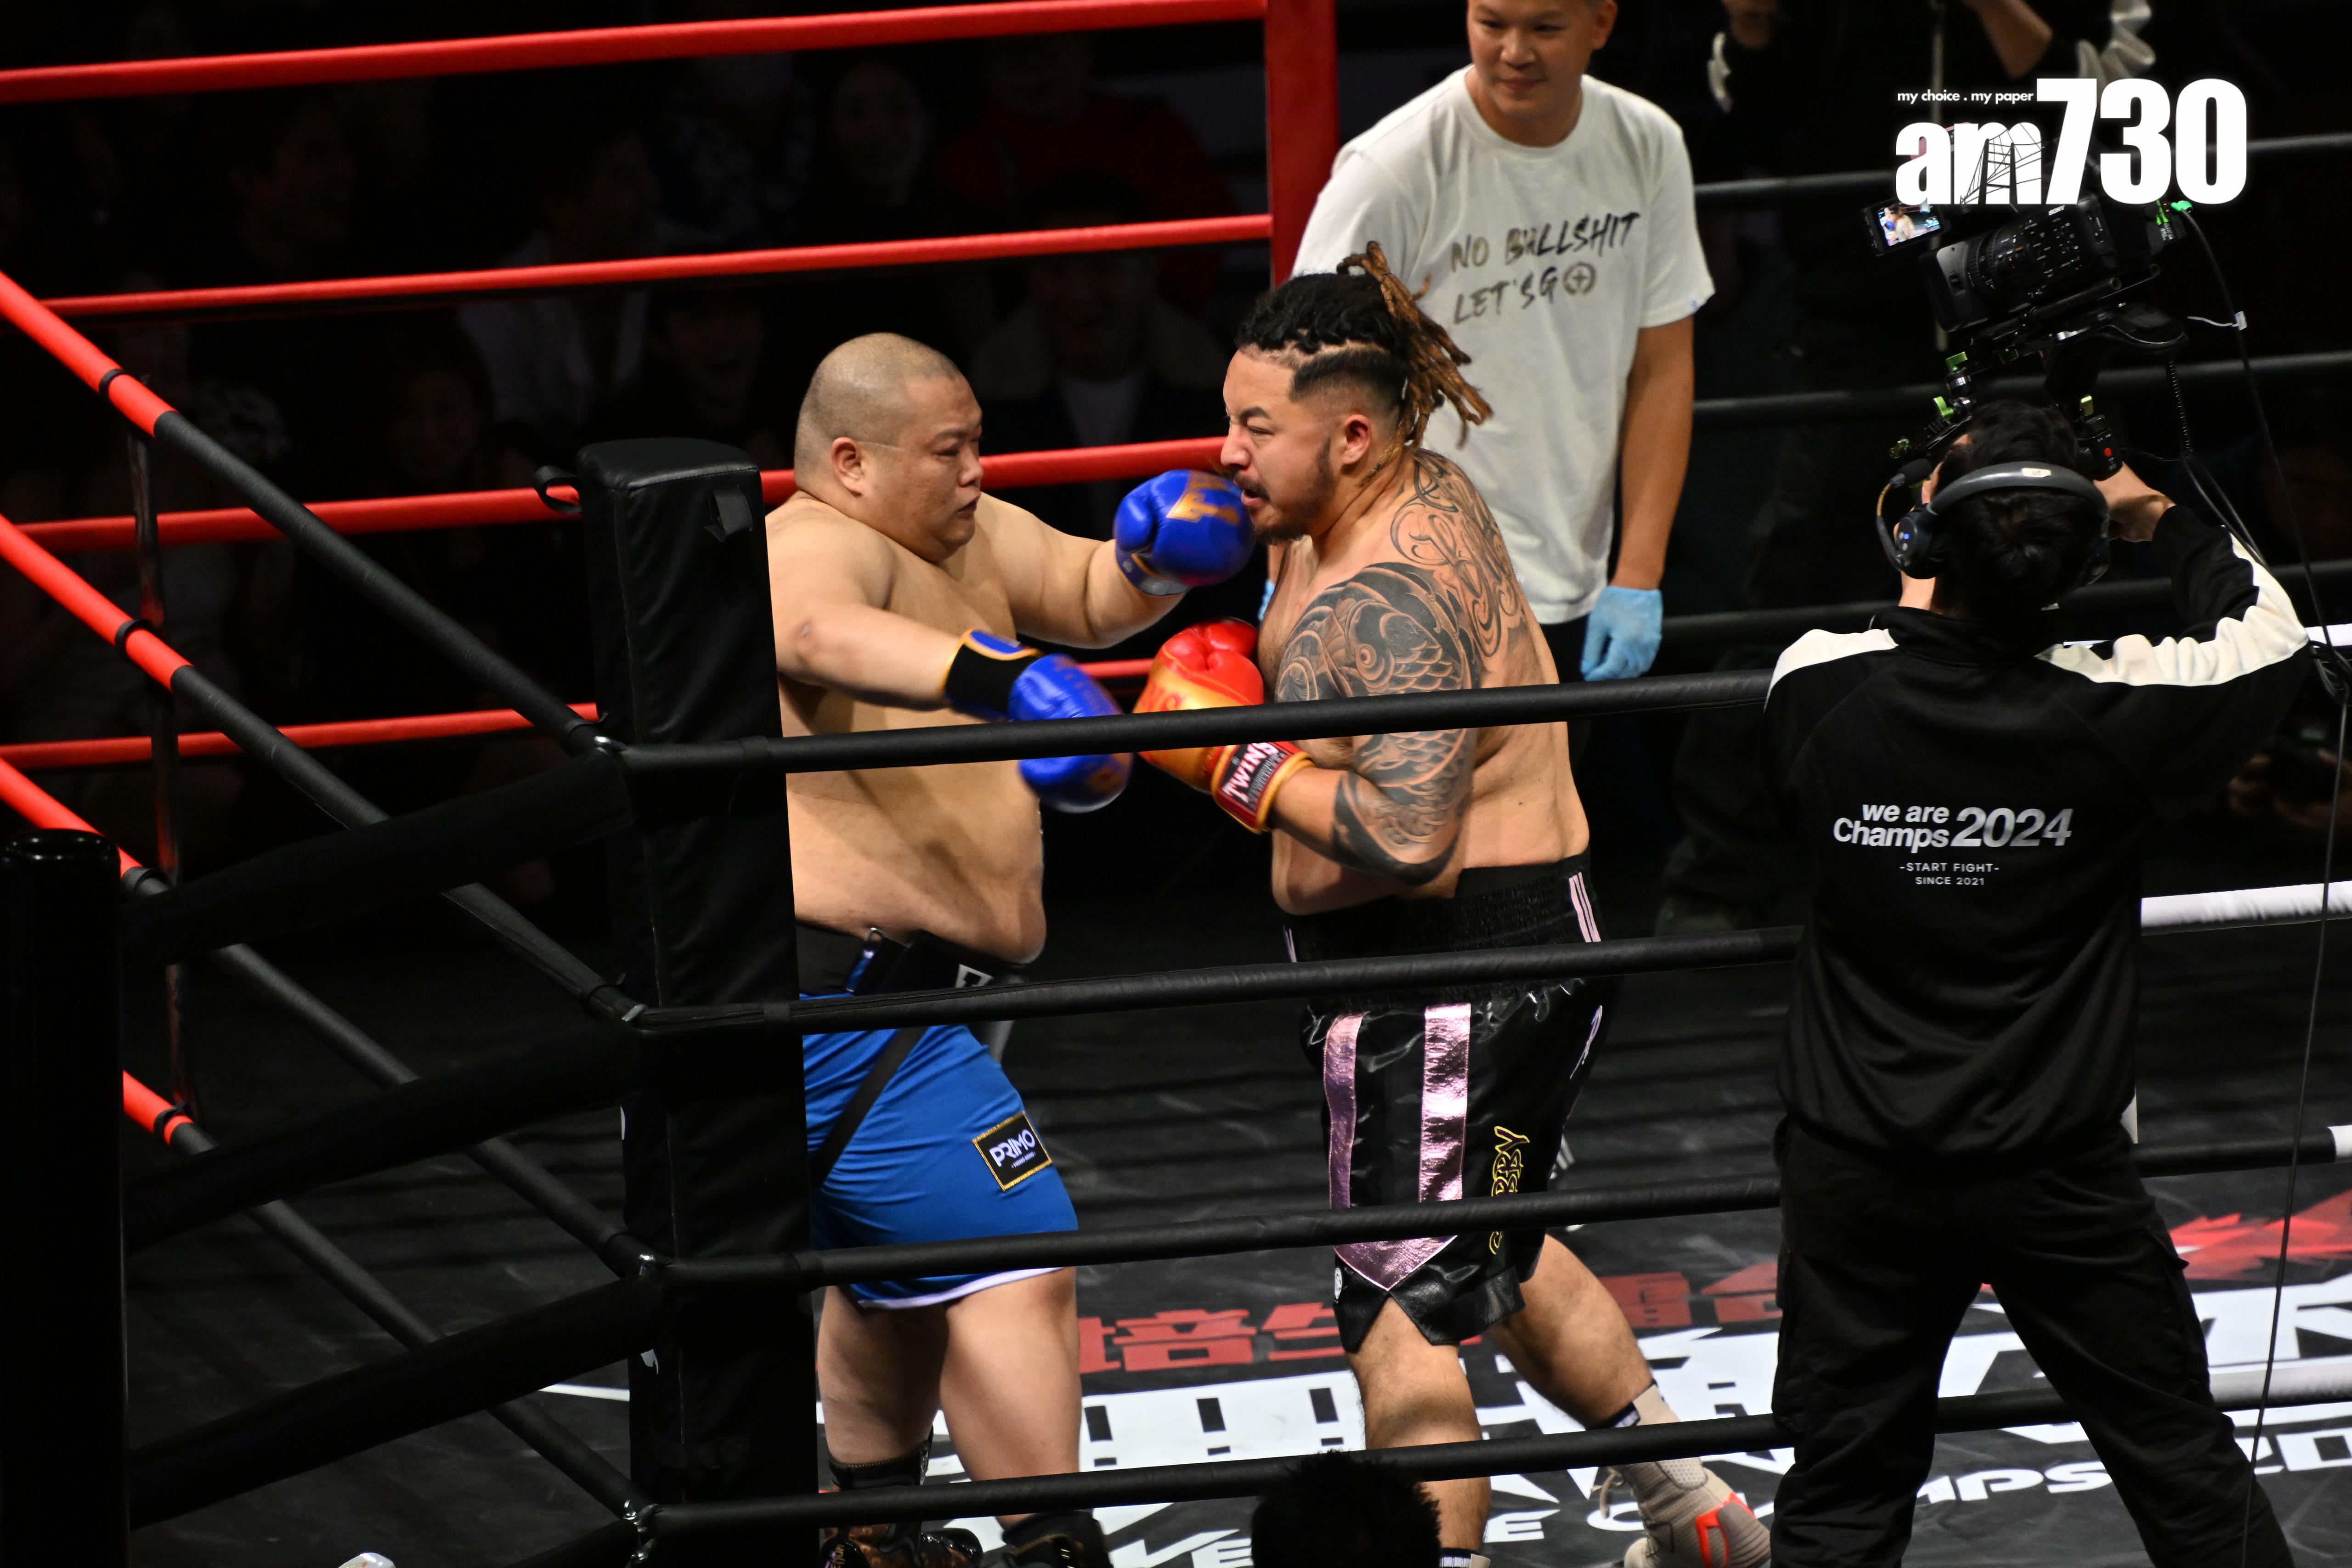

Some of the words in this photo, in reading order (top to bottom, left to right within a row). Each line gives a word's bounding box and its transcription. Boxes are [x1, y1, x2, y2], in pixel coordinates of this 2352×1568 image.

[1451, 235, 1489, 272] NO
[1222, 742, 1279, 804] TWINS
[1833, 818, 1950, 854] Champs
[1950, 807, 2074, 847] 2024
[1862, 804, 1900, 822] we
[1905, 806, 1950, 823] are
[1915, 876, 1952, 885] SINCE
[1956, 877, 1984, 886] 2021
[989, 1129, 1035, 1168] PRIMO
[1489, 1125, 1531, 1255] BBY
